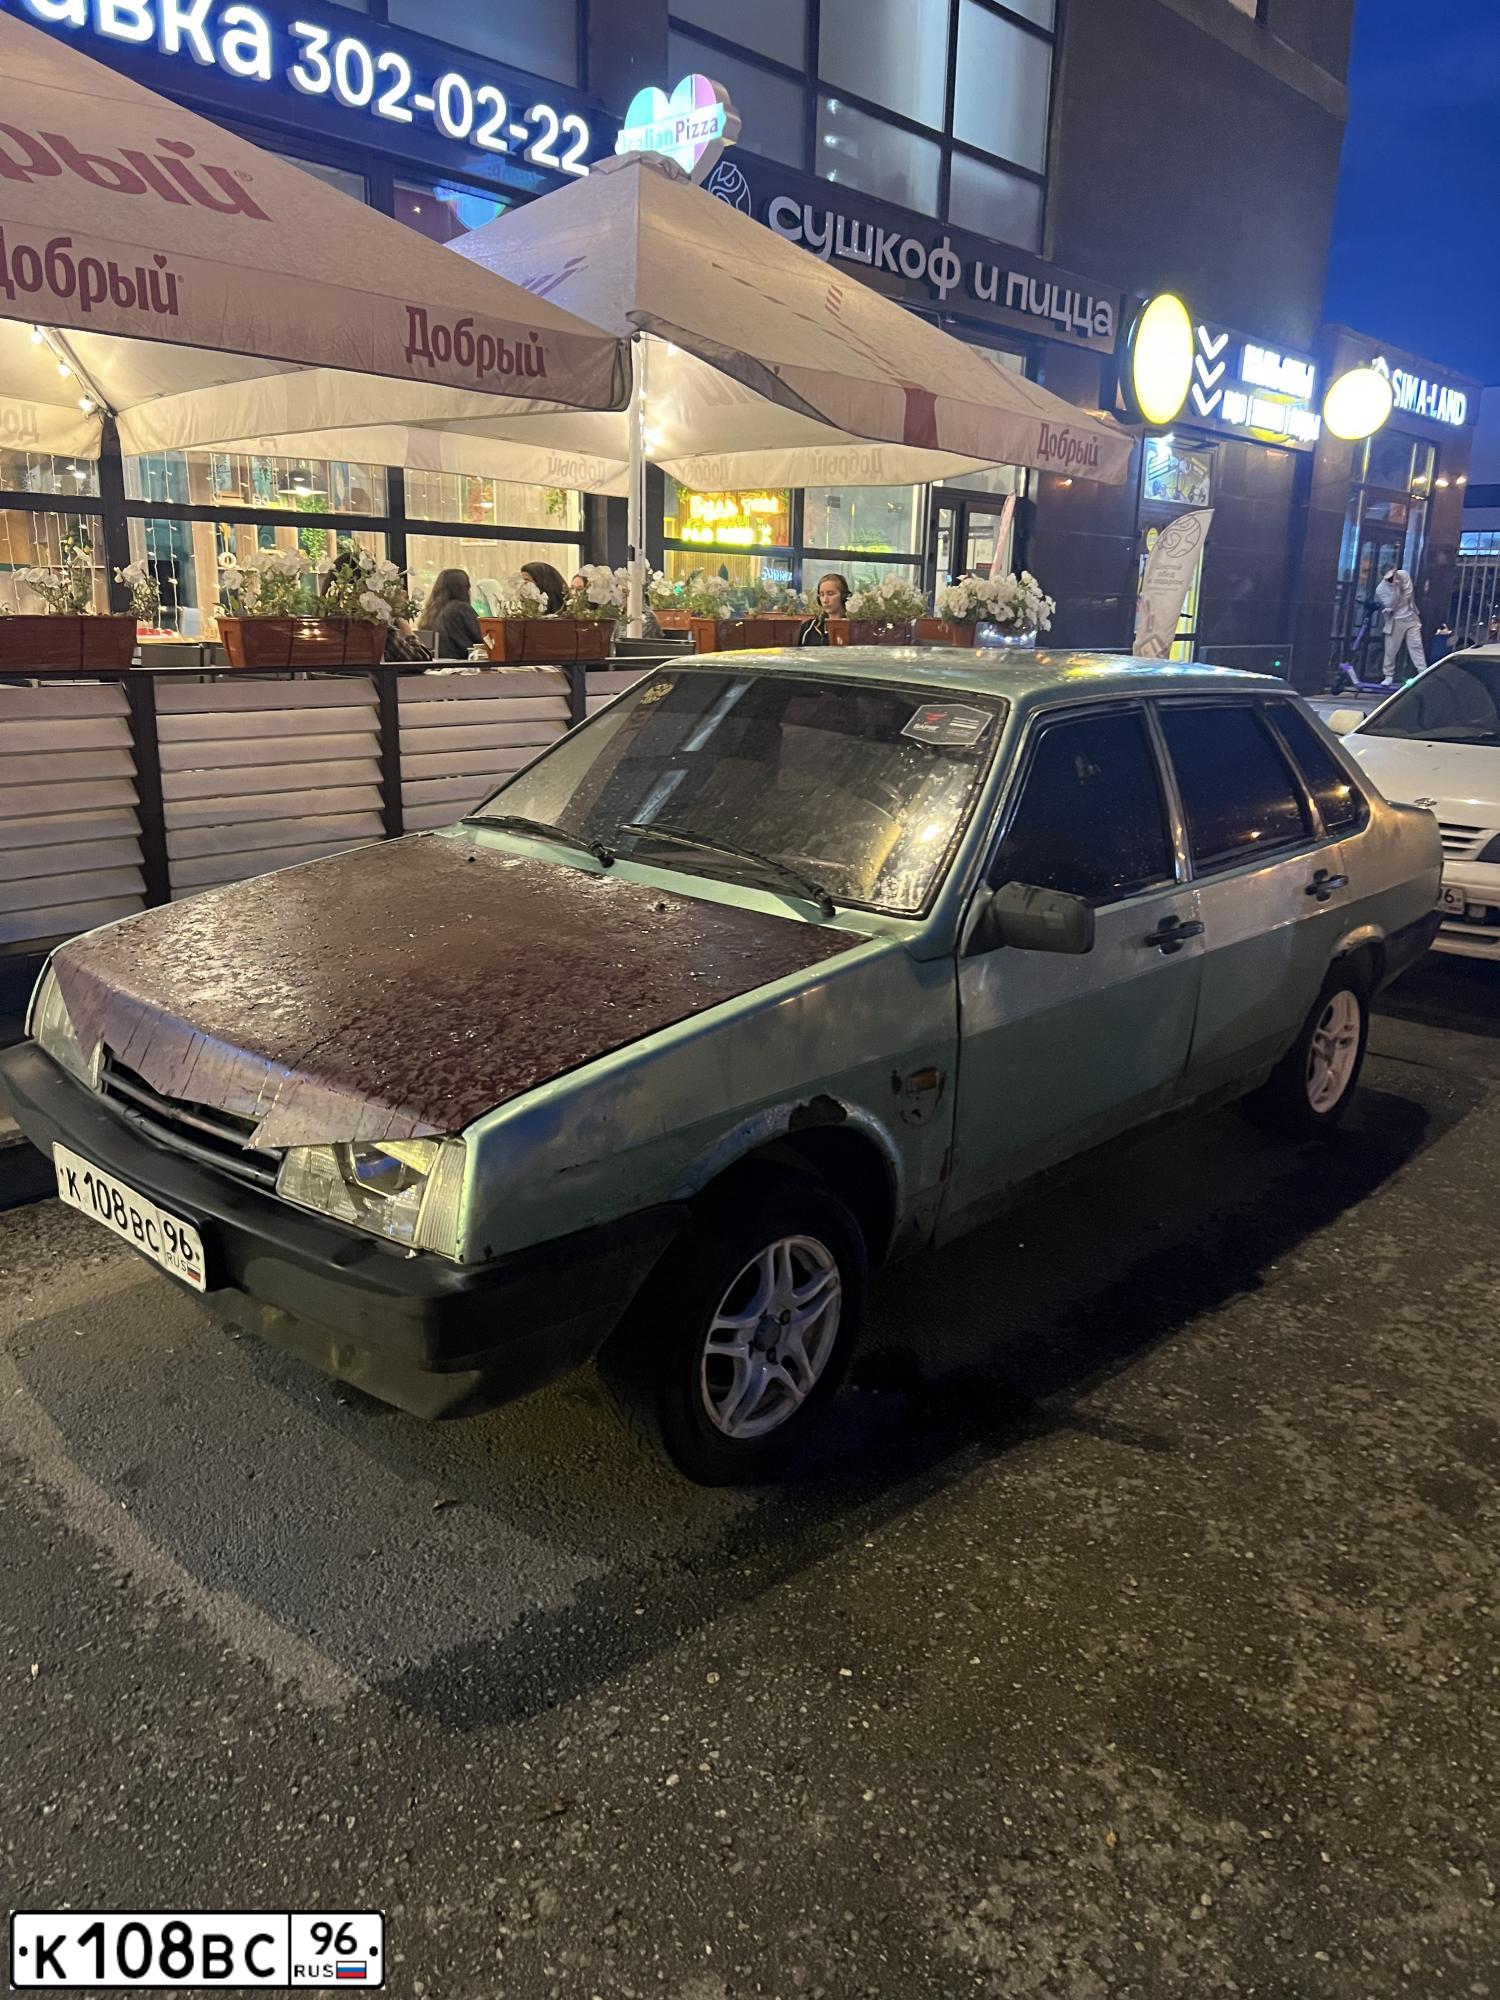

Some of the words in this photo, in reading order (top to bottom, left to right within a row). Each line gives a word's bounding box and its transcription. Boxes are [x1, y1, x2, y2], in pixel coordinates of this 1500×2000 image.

[288, 21, 590, 177] 302-02-22
[974, 261, 999, 302] и
[1006, 271, 1113, 338] пицца
[404, 305, 548, 379] Добрый
[1392, 368, 1467, 426] SIMA-LAND
[1036, 422, 1099, 467] Добрый
[163, 1220, 193, 1260] 96
[166, 1252, 188, 1272] RUS
